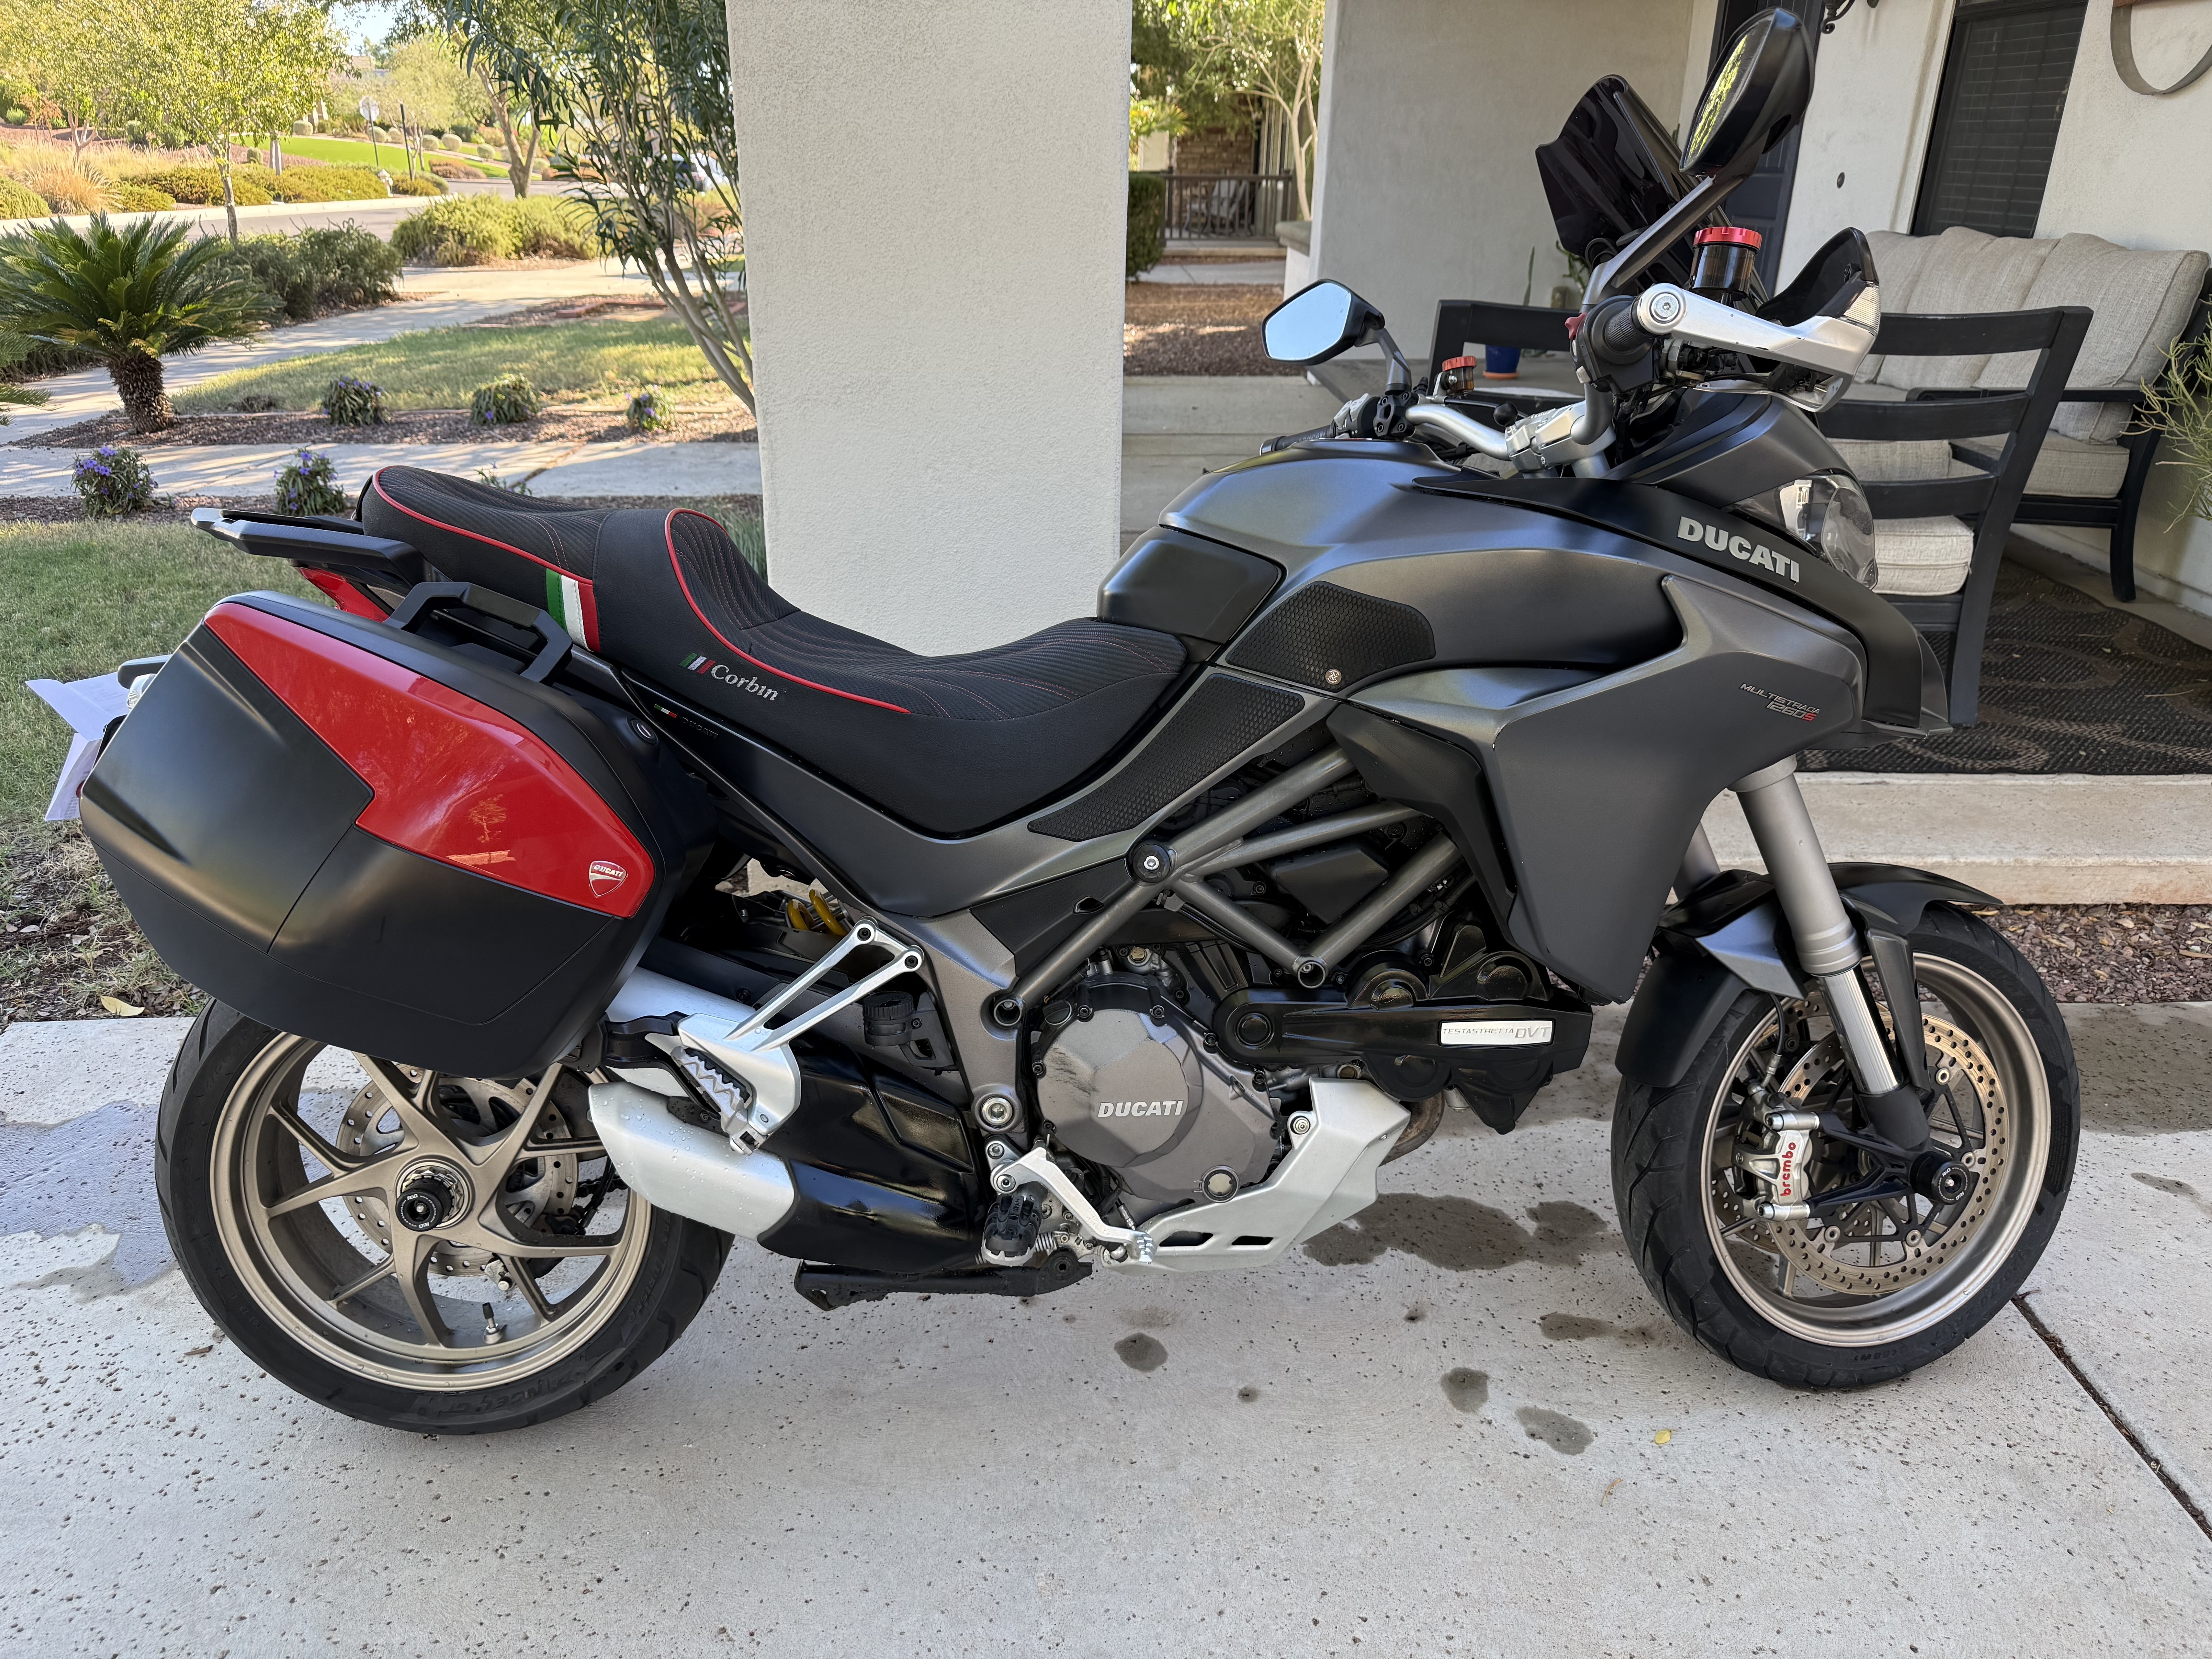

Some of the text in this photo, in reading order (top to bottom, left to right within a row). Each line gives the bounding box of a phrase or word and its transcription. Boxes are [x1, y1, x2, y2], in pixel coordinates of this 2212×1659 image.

[1678, 517, 1799, 582] DUCATI
[711, 665, 778, 700] Corbin
[1740, 684, 1820, 714] MULTISTRADA
[1766, 701, 1817, 721] 1260S
[682, 717, 718, 739] DUCATI
[593, 864, 624, 877] DUCATI
[1515, 1026, 1551, 1038] DVT
[1098, 1100, 1183, 1118] DUCATI
[1780, 1142, 1796, 1197] brembo
